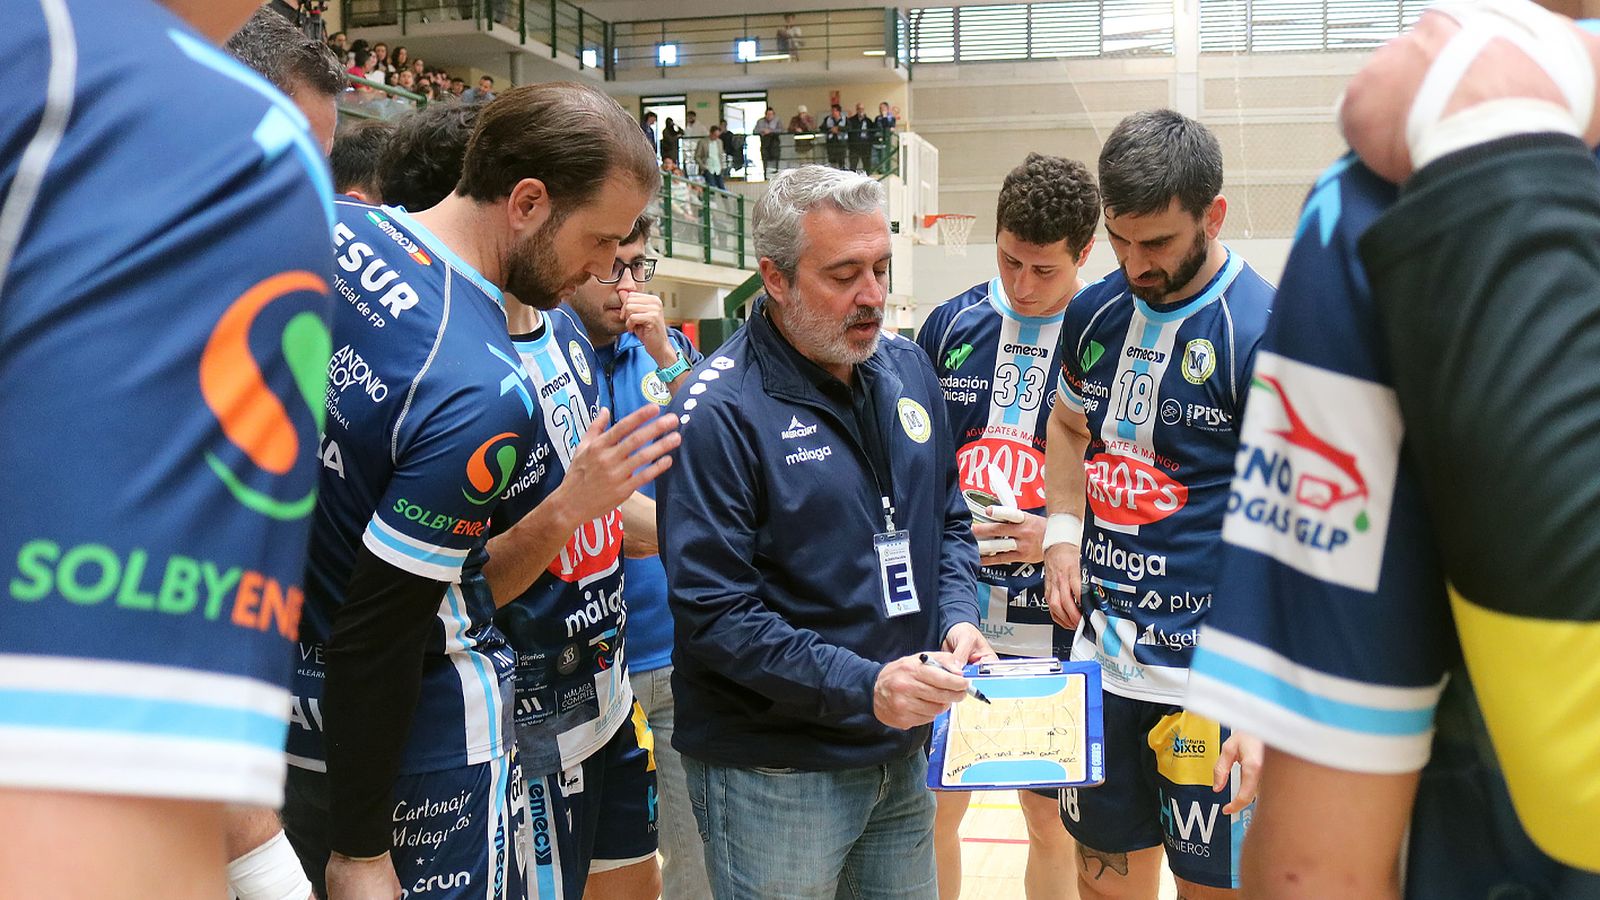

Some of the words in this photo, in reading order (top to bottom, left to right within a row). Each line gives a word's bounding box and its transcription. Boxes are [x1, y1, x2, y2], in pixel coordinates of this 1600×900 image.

[378, 220, 411, 250] emec
[356, 301, 371, 317] de
[368, 312, 386, 329] FP
[1004, 343, 1038, 357] emec
[1126, 346, 1154, 361] emec
[334, 344, 388, 403] ANTONIO
[993, 362, 1047, 412] 33
[1115, 369, 1154, 426] 18
[781, 424, 818, 440] MERCURY
[965, 425, 1011, 439] AGUCATE
[1011, 427, 1018, 438] &
[1131, 444, 1139, 455] &
[1140, 447, 1181, 473] MANGO
[1084, 461, 1180, 512] TROPS
[1294, 516, 1349, 554] GLP
[885, 562, 914, 604] E
[1173, 736, 1206, 754] Sixto
[528, 783, 551, 848] emec
